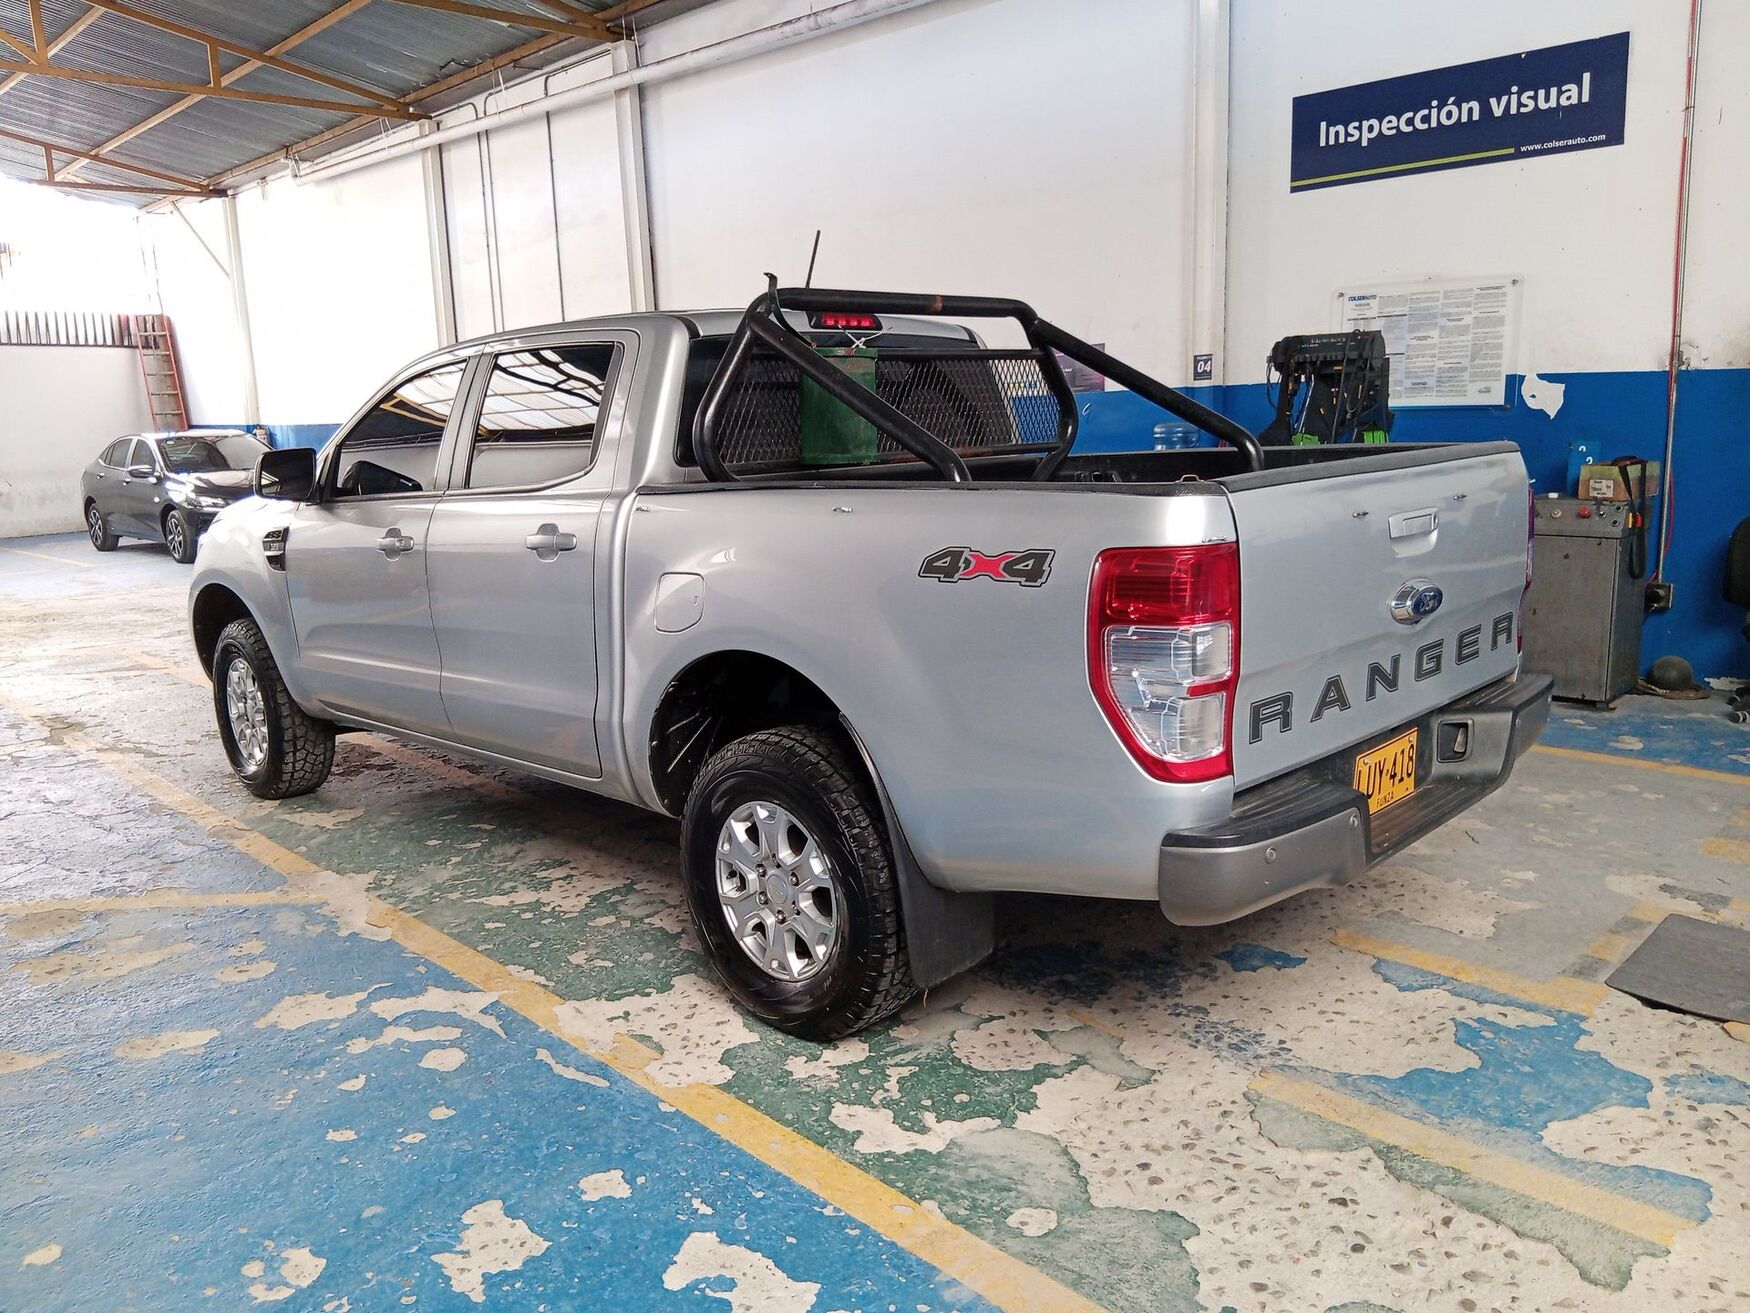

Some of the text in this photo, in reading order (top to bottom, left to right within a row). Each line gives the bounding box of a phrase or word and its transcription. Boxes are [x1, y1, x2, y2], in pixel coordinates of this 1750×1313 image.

[1319, 72, 1590, 147] Inspección visual
[1520, 134, 1606, 152] www.colserauto.com
[1197, 360, 1211, 373] 04
[1249, 611, 1513, 744] RANGER
